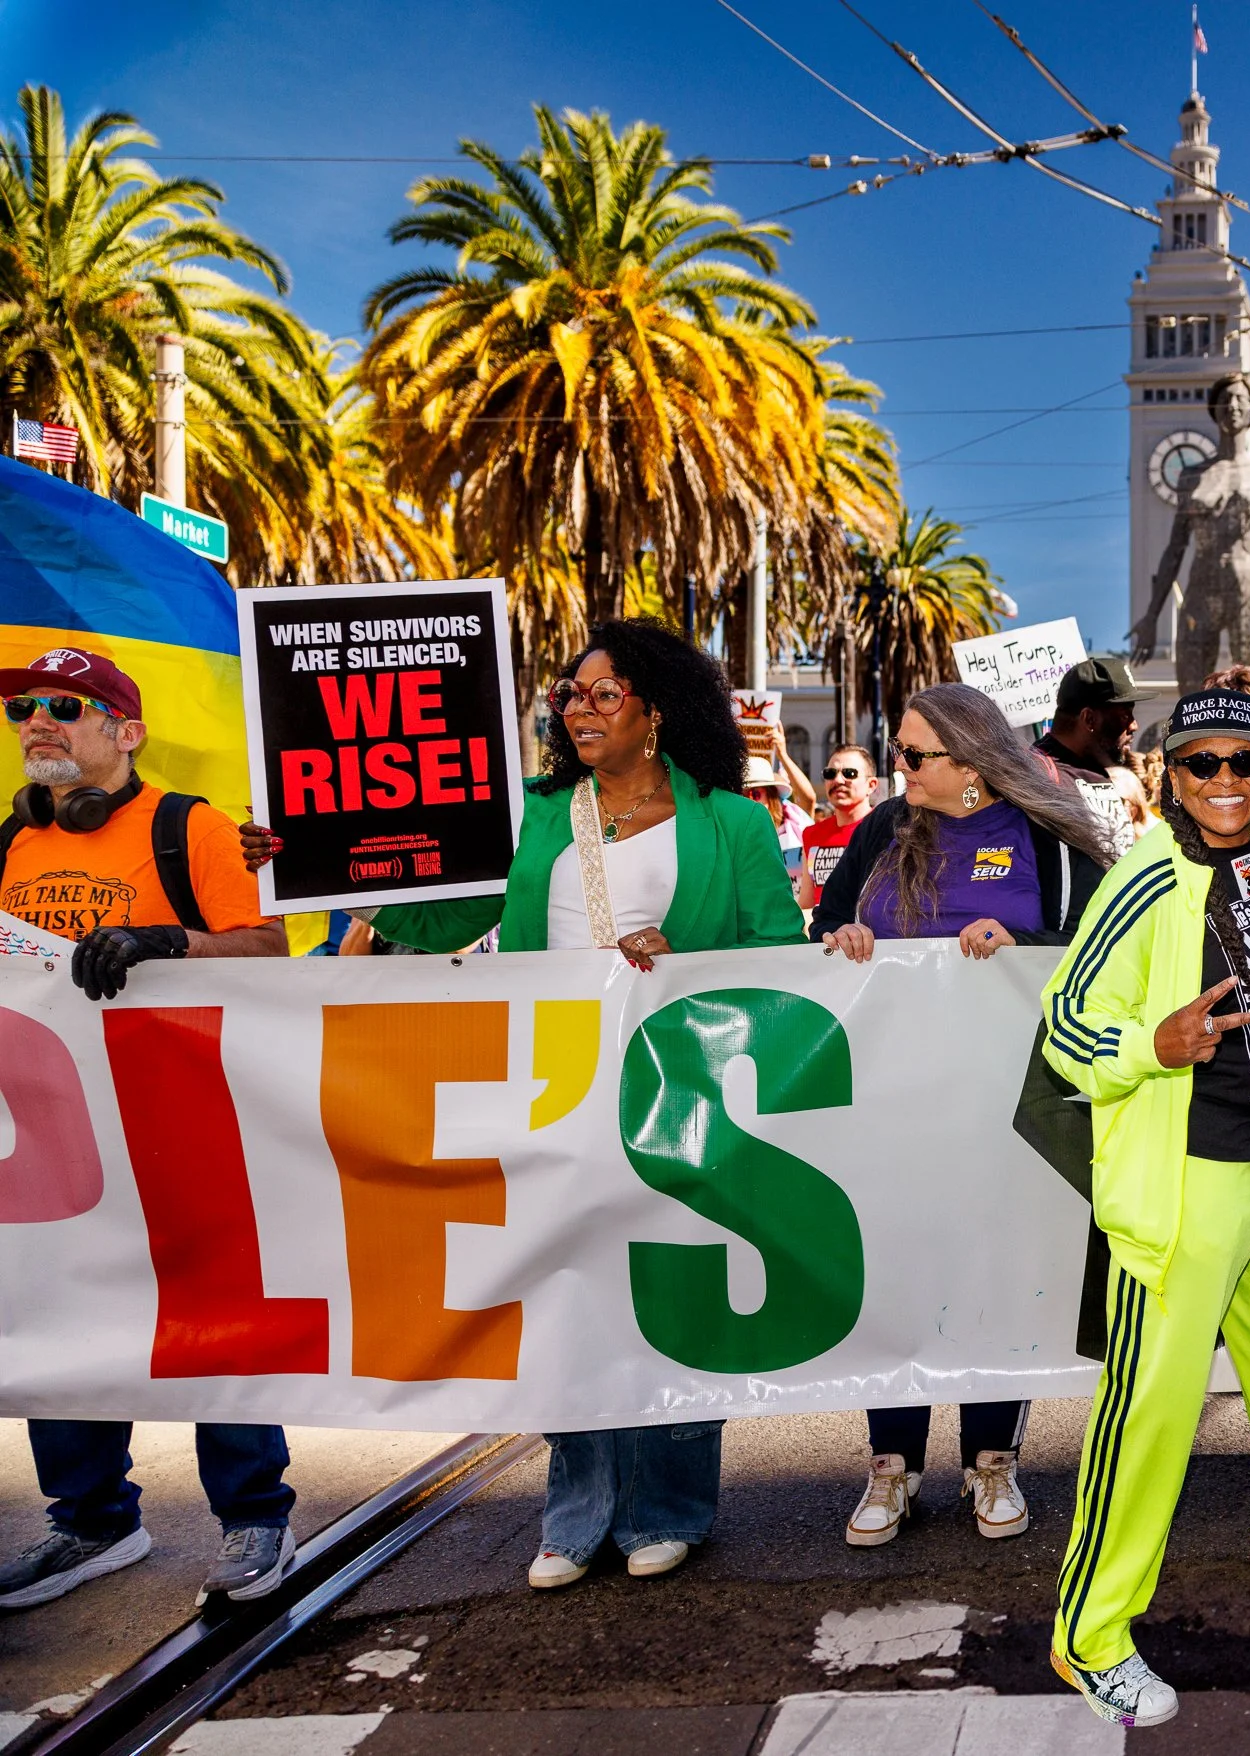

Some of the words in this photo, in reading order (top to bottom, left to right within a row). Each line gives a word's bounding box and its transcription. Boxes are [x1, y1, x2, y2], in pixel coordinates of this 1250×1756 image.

[162, 511, 209, 548] Market
[269, 622, 343, 646] WHEN
[349, 615, 482, 643] SURVIVORS
[45, 649, 77, 660] PHILLY
[291, 649, 340, 672] ARE
[347, 642, 467, 669] SILENCED,
[965, 652, 1001, 681] Hey
[1003, 641, 1063, 665] Trump,
[317, 669, 447, 740] WE
[1004, 688, 1051, 713] instead
[1182, 698, 1215, 714] MAKE
[1182, 709, 1225, 726] WRONG
[281, 737, 491, 816] RISE!
[350, 840, 439, 853] #UNTILTHEVIOLENCESTOPS
[361, 833, 427, 845] onebillionrising.org
[417, 852, 440, 863] BILLION
[815, 858, 840, 870] FAMI
[418, 862, 441, 876] RISING
[971, 866, 1010, 878] SEIU
[6, 891, 30, 911] I'LL
[37, 885, 85, 904] TAKE
[88, 886, 118, 907] MY
